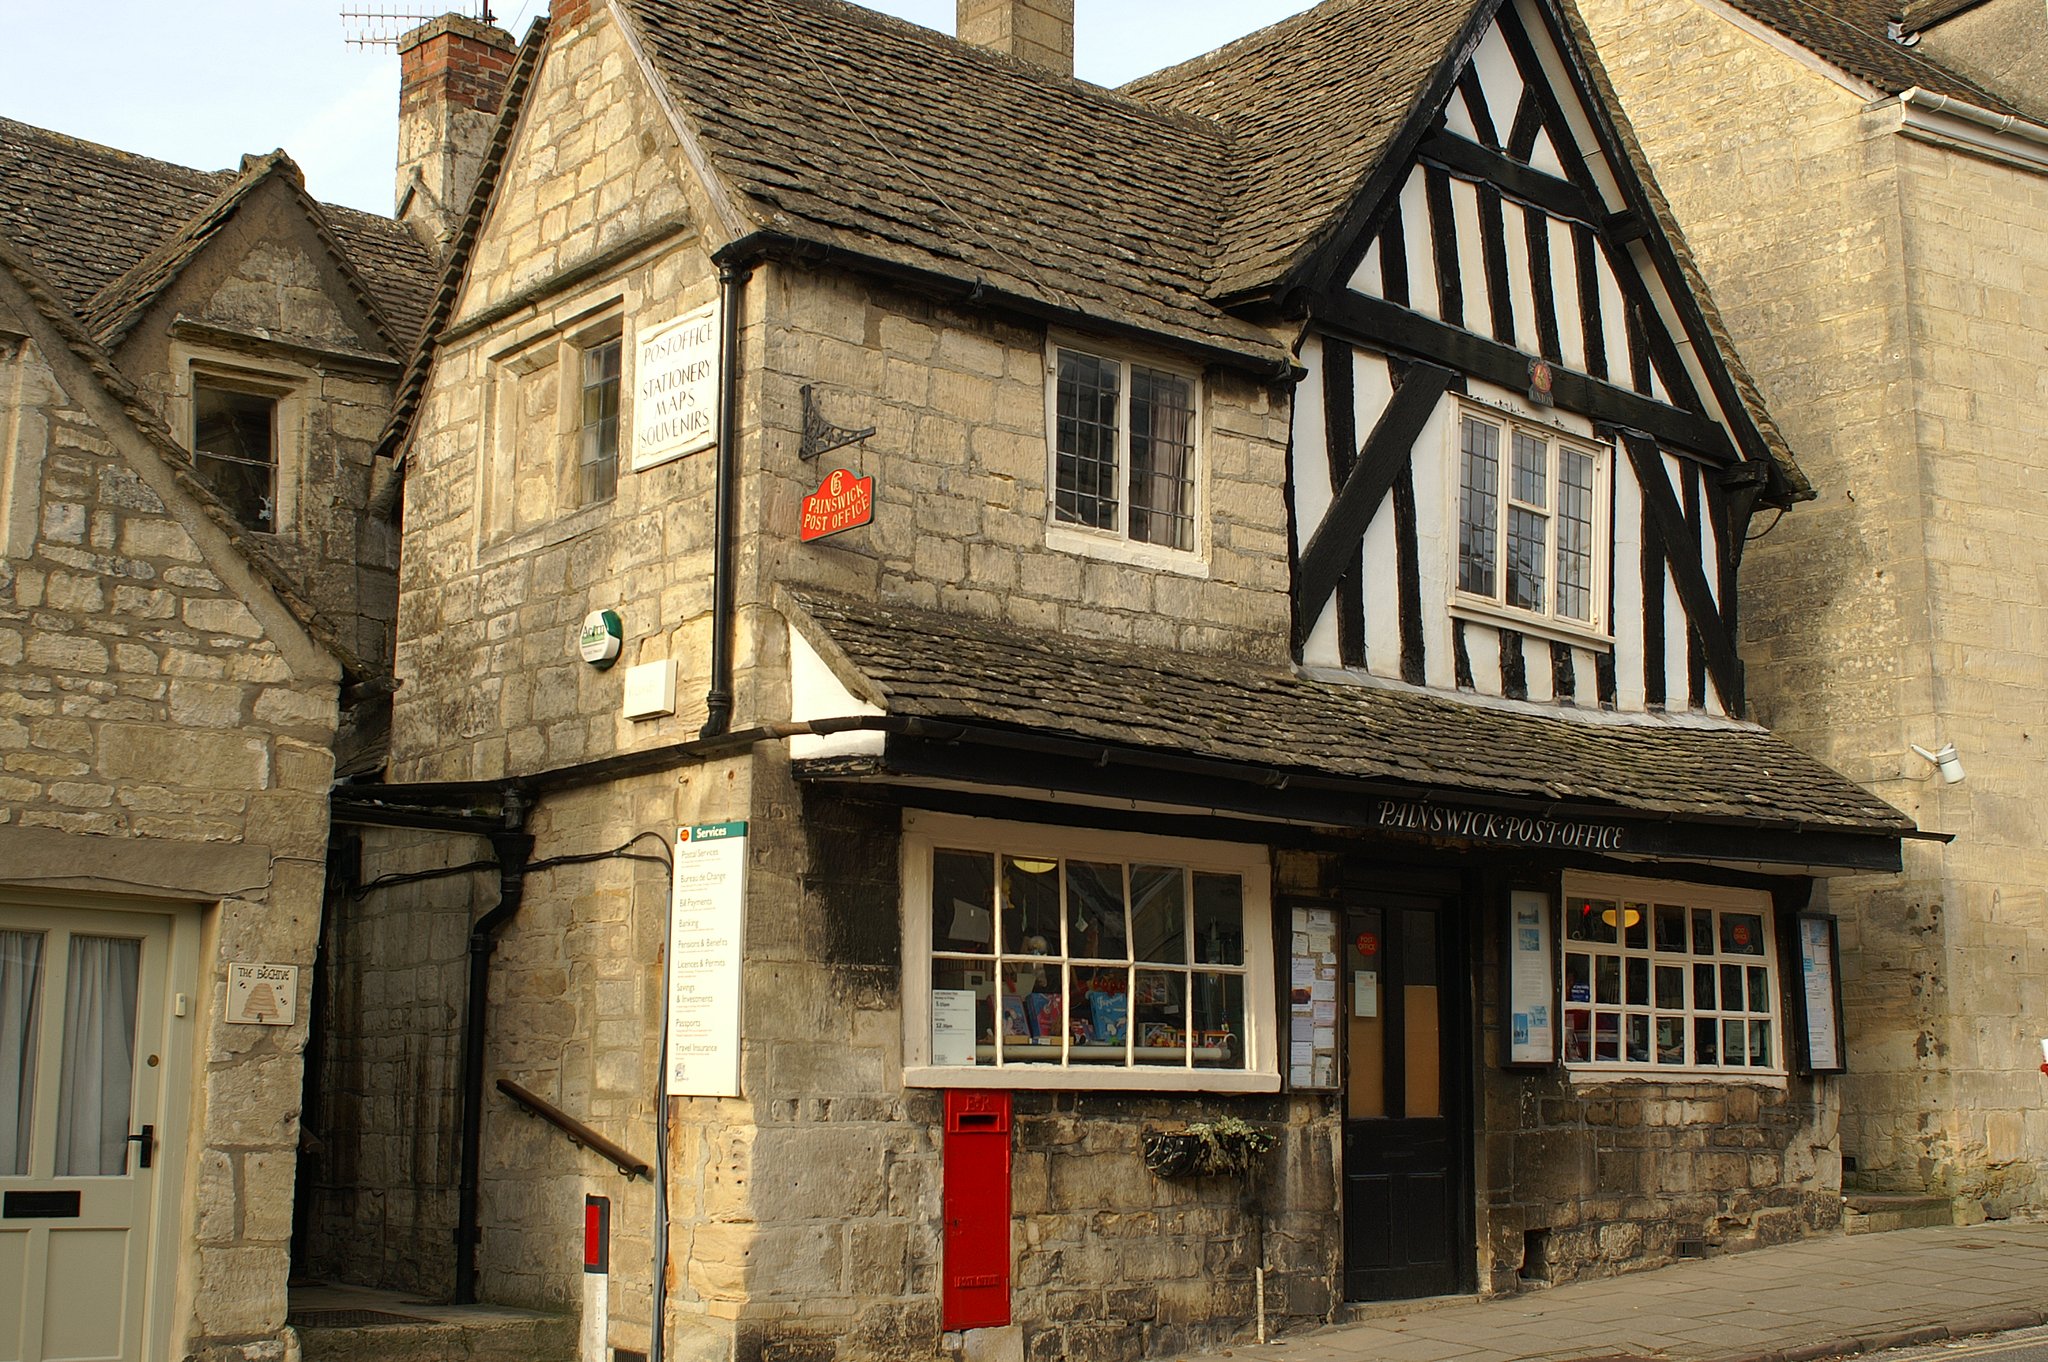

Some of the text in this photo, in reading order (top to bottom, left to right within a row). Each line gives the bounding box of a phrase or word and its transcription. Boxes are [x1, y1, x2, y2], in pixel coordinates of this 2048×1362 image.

[643, 359, 711, 400] STATIONERY
[655, 387, 695, 416] MAPS
[641, 407, 710, 449] SOUVENIRS
[803, 493, 869, 531] POST OFFICE
[808, 481, 864, 514] PAINSWICK
[696, 826, 727, 839] Services
[1378, 799, 1625, 849] PAINSWICK POST OFFICE
[237, 967, 290, 981] THE BEEHIVE
